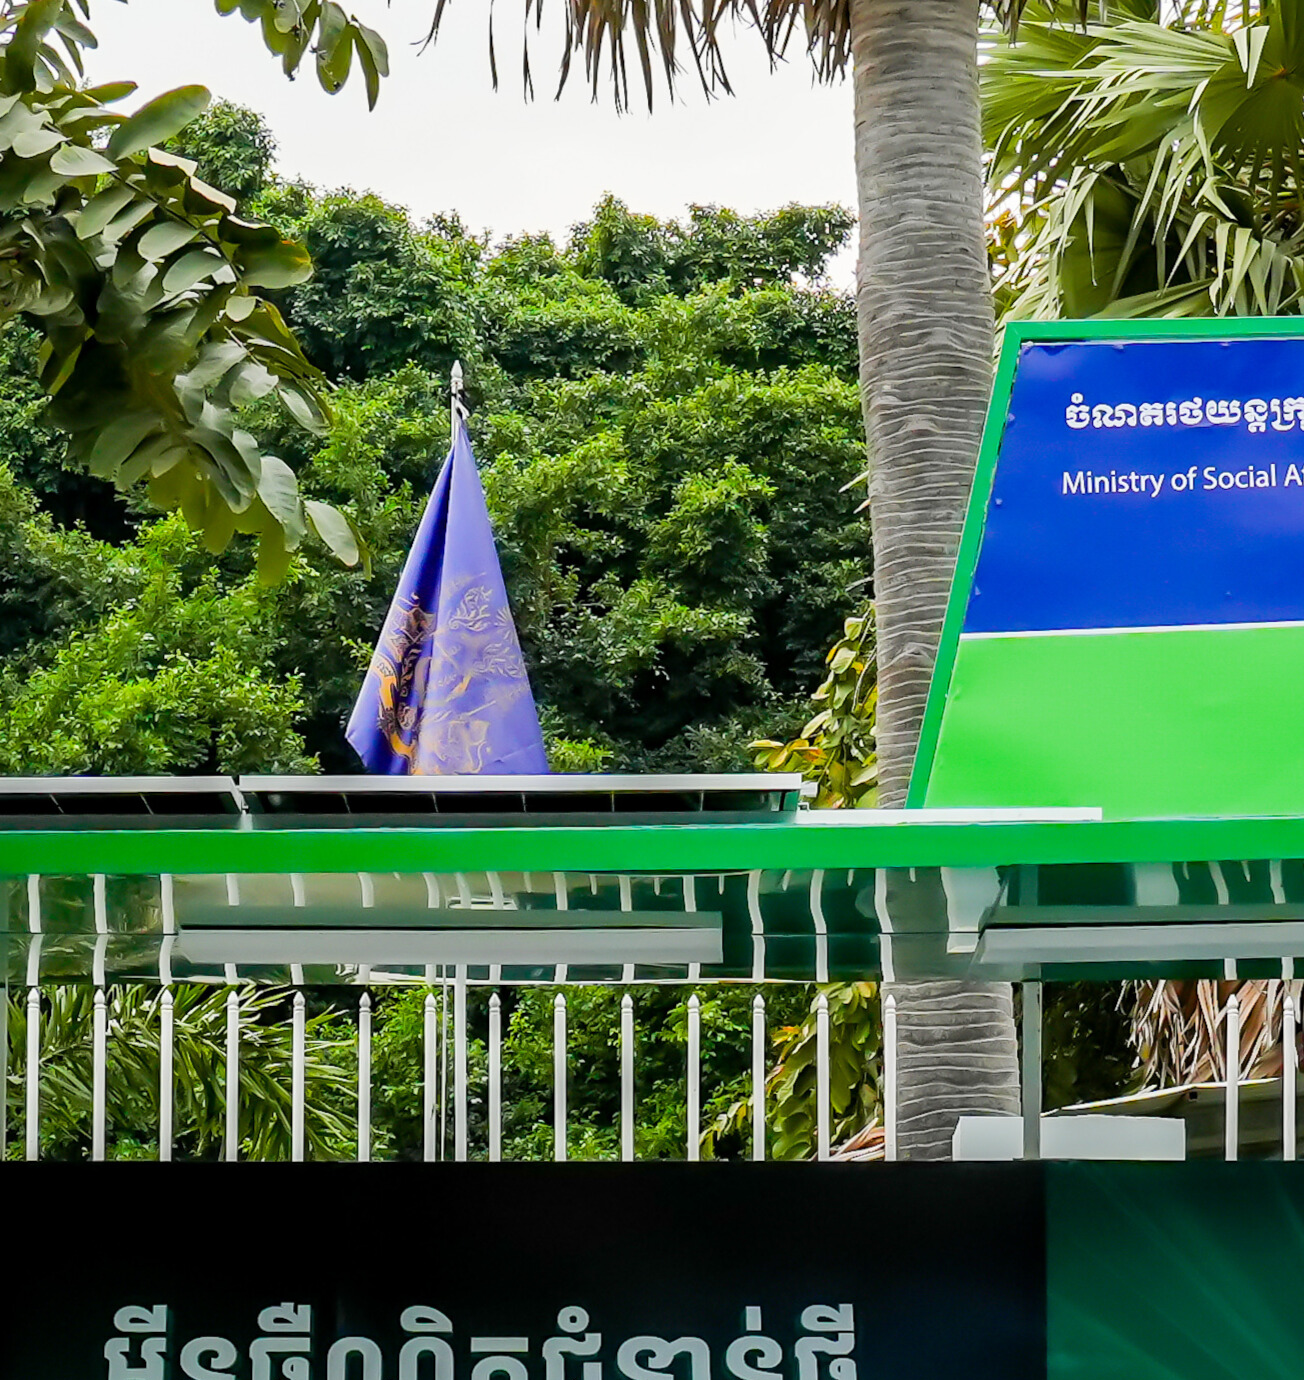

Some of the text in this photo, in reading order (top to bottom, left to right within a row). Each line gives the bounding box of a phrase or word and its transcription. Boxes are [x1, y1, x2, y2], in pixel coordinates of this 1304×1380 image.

[1062, 470, 1165, 498] Ministry
[1171, 466, 1197, 491] of
[1203, 464, 1276, 490] Social
